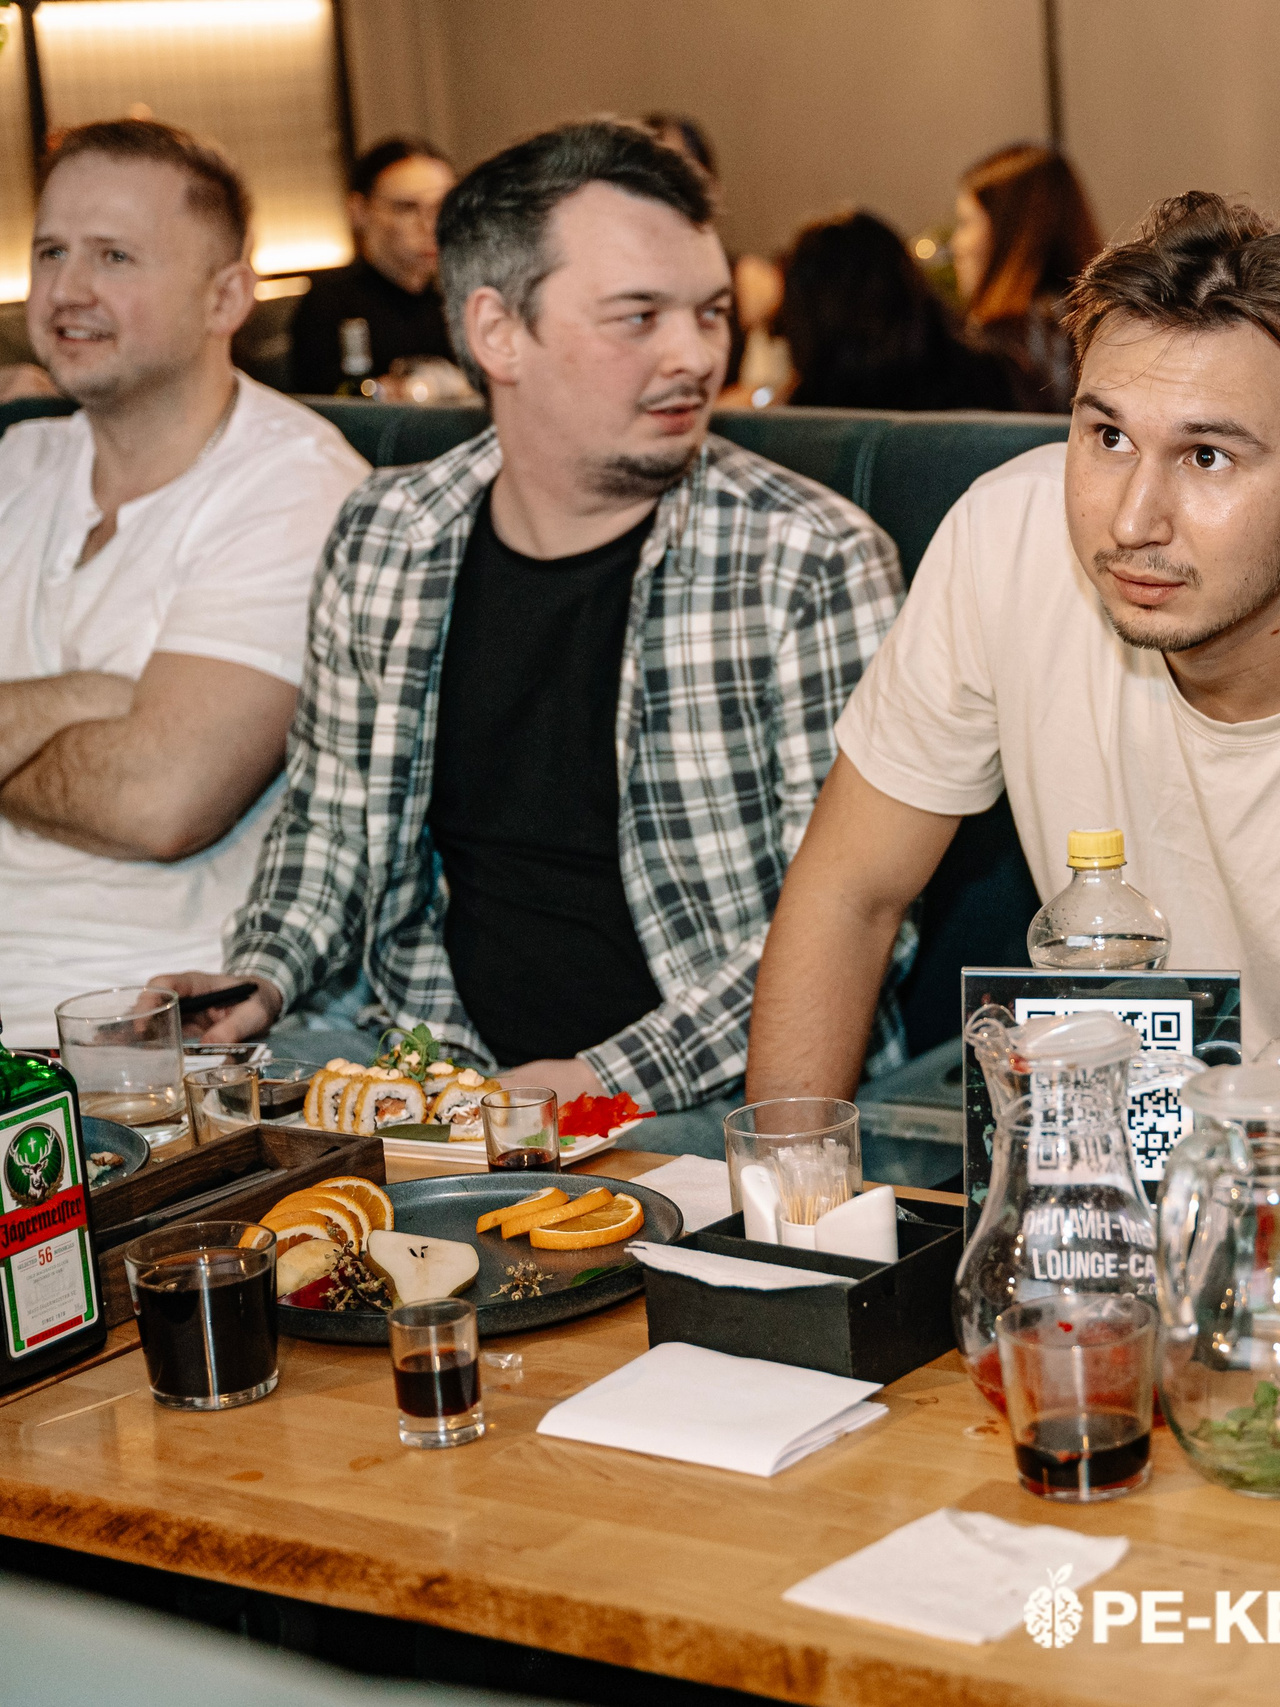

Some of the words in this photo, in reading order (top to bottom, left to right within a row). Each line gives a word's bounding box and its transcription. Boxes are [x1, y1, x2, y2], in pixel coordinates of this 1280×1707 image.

[1023, 1202, 1157, 1250] ОНЛАЙН-МЕ
[38, 1246, 53, 1266] 56
[1032, 1248, 1157, 1281] LOUNGE-CA
